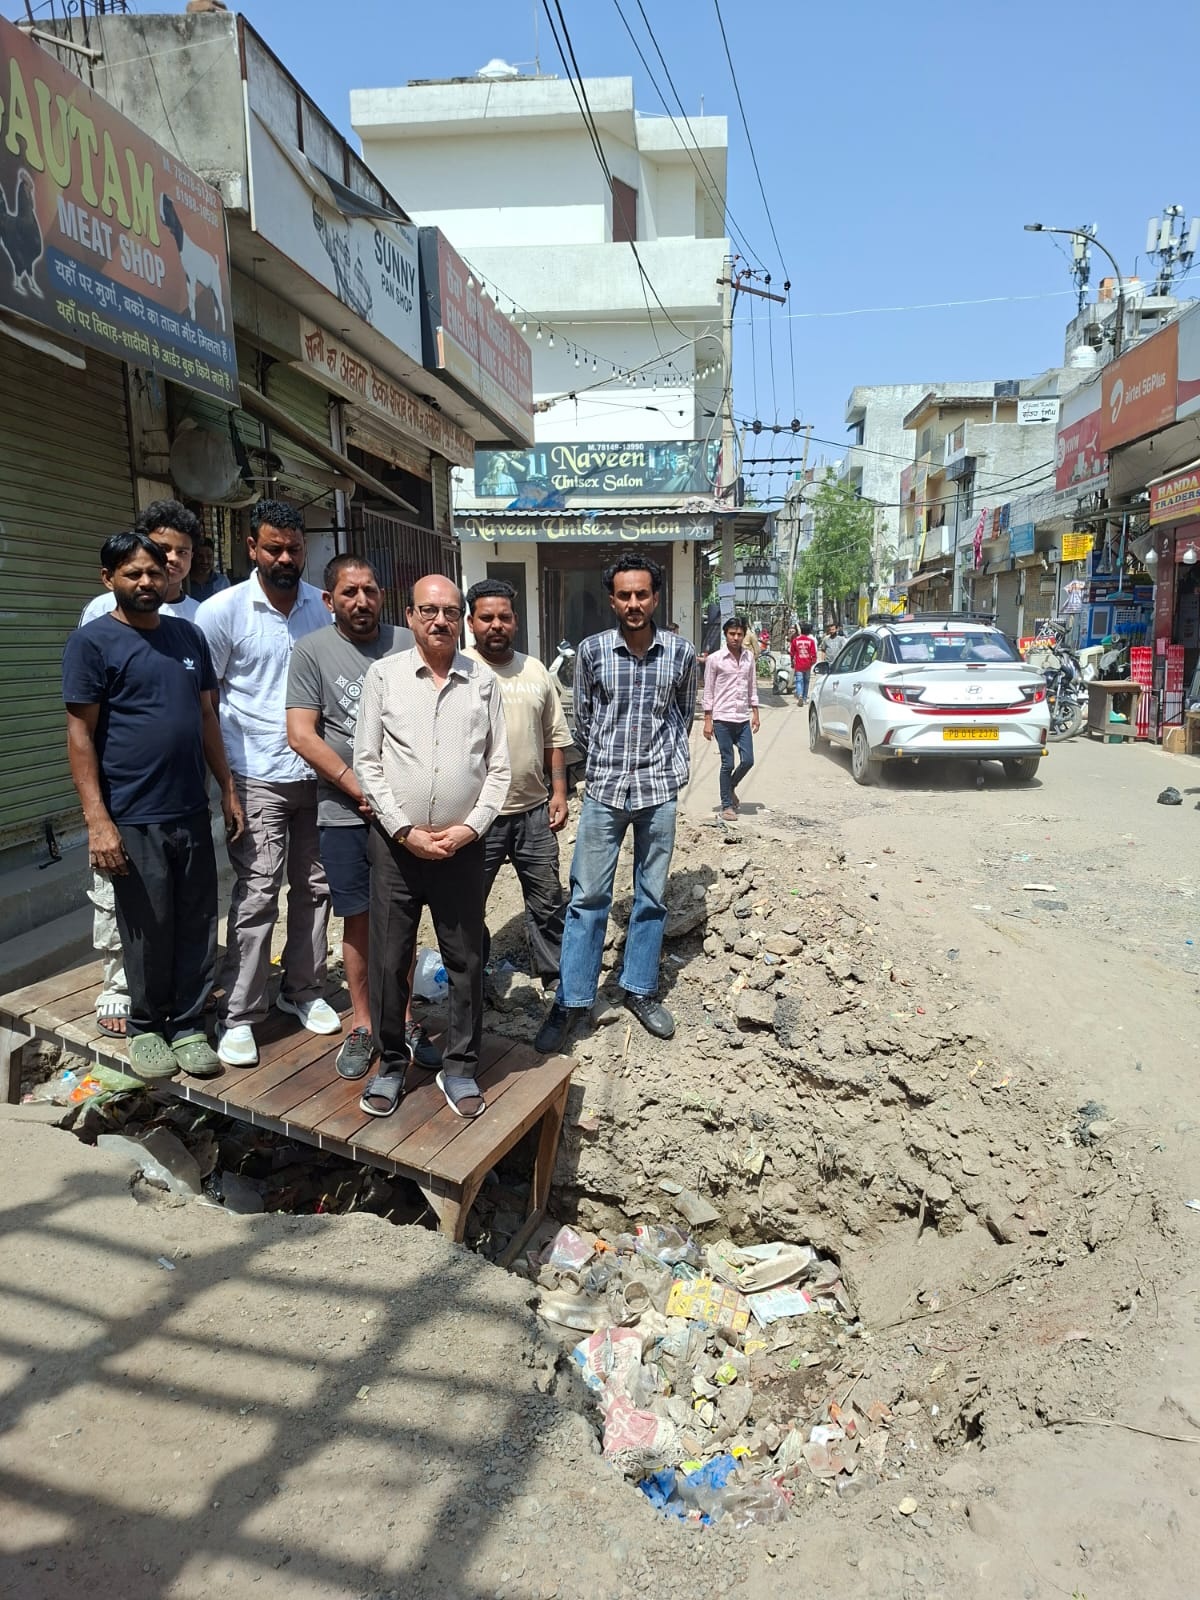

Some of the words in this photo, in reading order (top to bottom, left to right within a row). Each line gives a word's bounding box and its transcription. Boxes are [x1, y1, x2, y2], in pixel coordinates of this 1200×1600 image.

[0, 56, 161, 247] AUTAM
[57, 196, 113, 262] MEAT
[119, 232, 166, 289] SHOP
[374, 229, 415, 297] SUNNY
[55, 259, 77, 287] यहाँ
[78, 271, 94, 295] पर
[123, 295, 146, 321] बकरे
[146, 307, 160, 328] का
[197, 328, 222, 356] मिलता
[381, 272, 395, 301] PAN
[396, 287, 413, 315] SHOP
[55, 299, 77, 325] यहाँ
[77, 309, 92, 331] पर
[151, 339, 161, 360] के
[446, 297, 478, 357] ENGLISH
[1125, 381, 1141, 405] airtel
[551, 445, 647, 475] Naveen
[551, 474, 600, 490] Unisex
[603, 473, 643, 491] Salon
[1158, 475, 1199, 499] HANDA
[1154, 489, 1200, 510] TRADERS
[464, 518, 537, 541] Naveen
[541, 518, 614, 540] Unisex
[620, 516, 681, 540] Salon
[501, 681, 541, 694] MAIN
[96, 1003, 131, 1018] NIK
